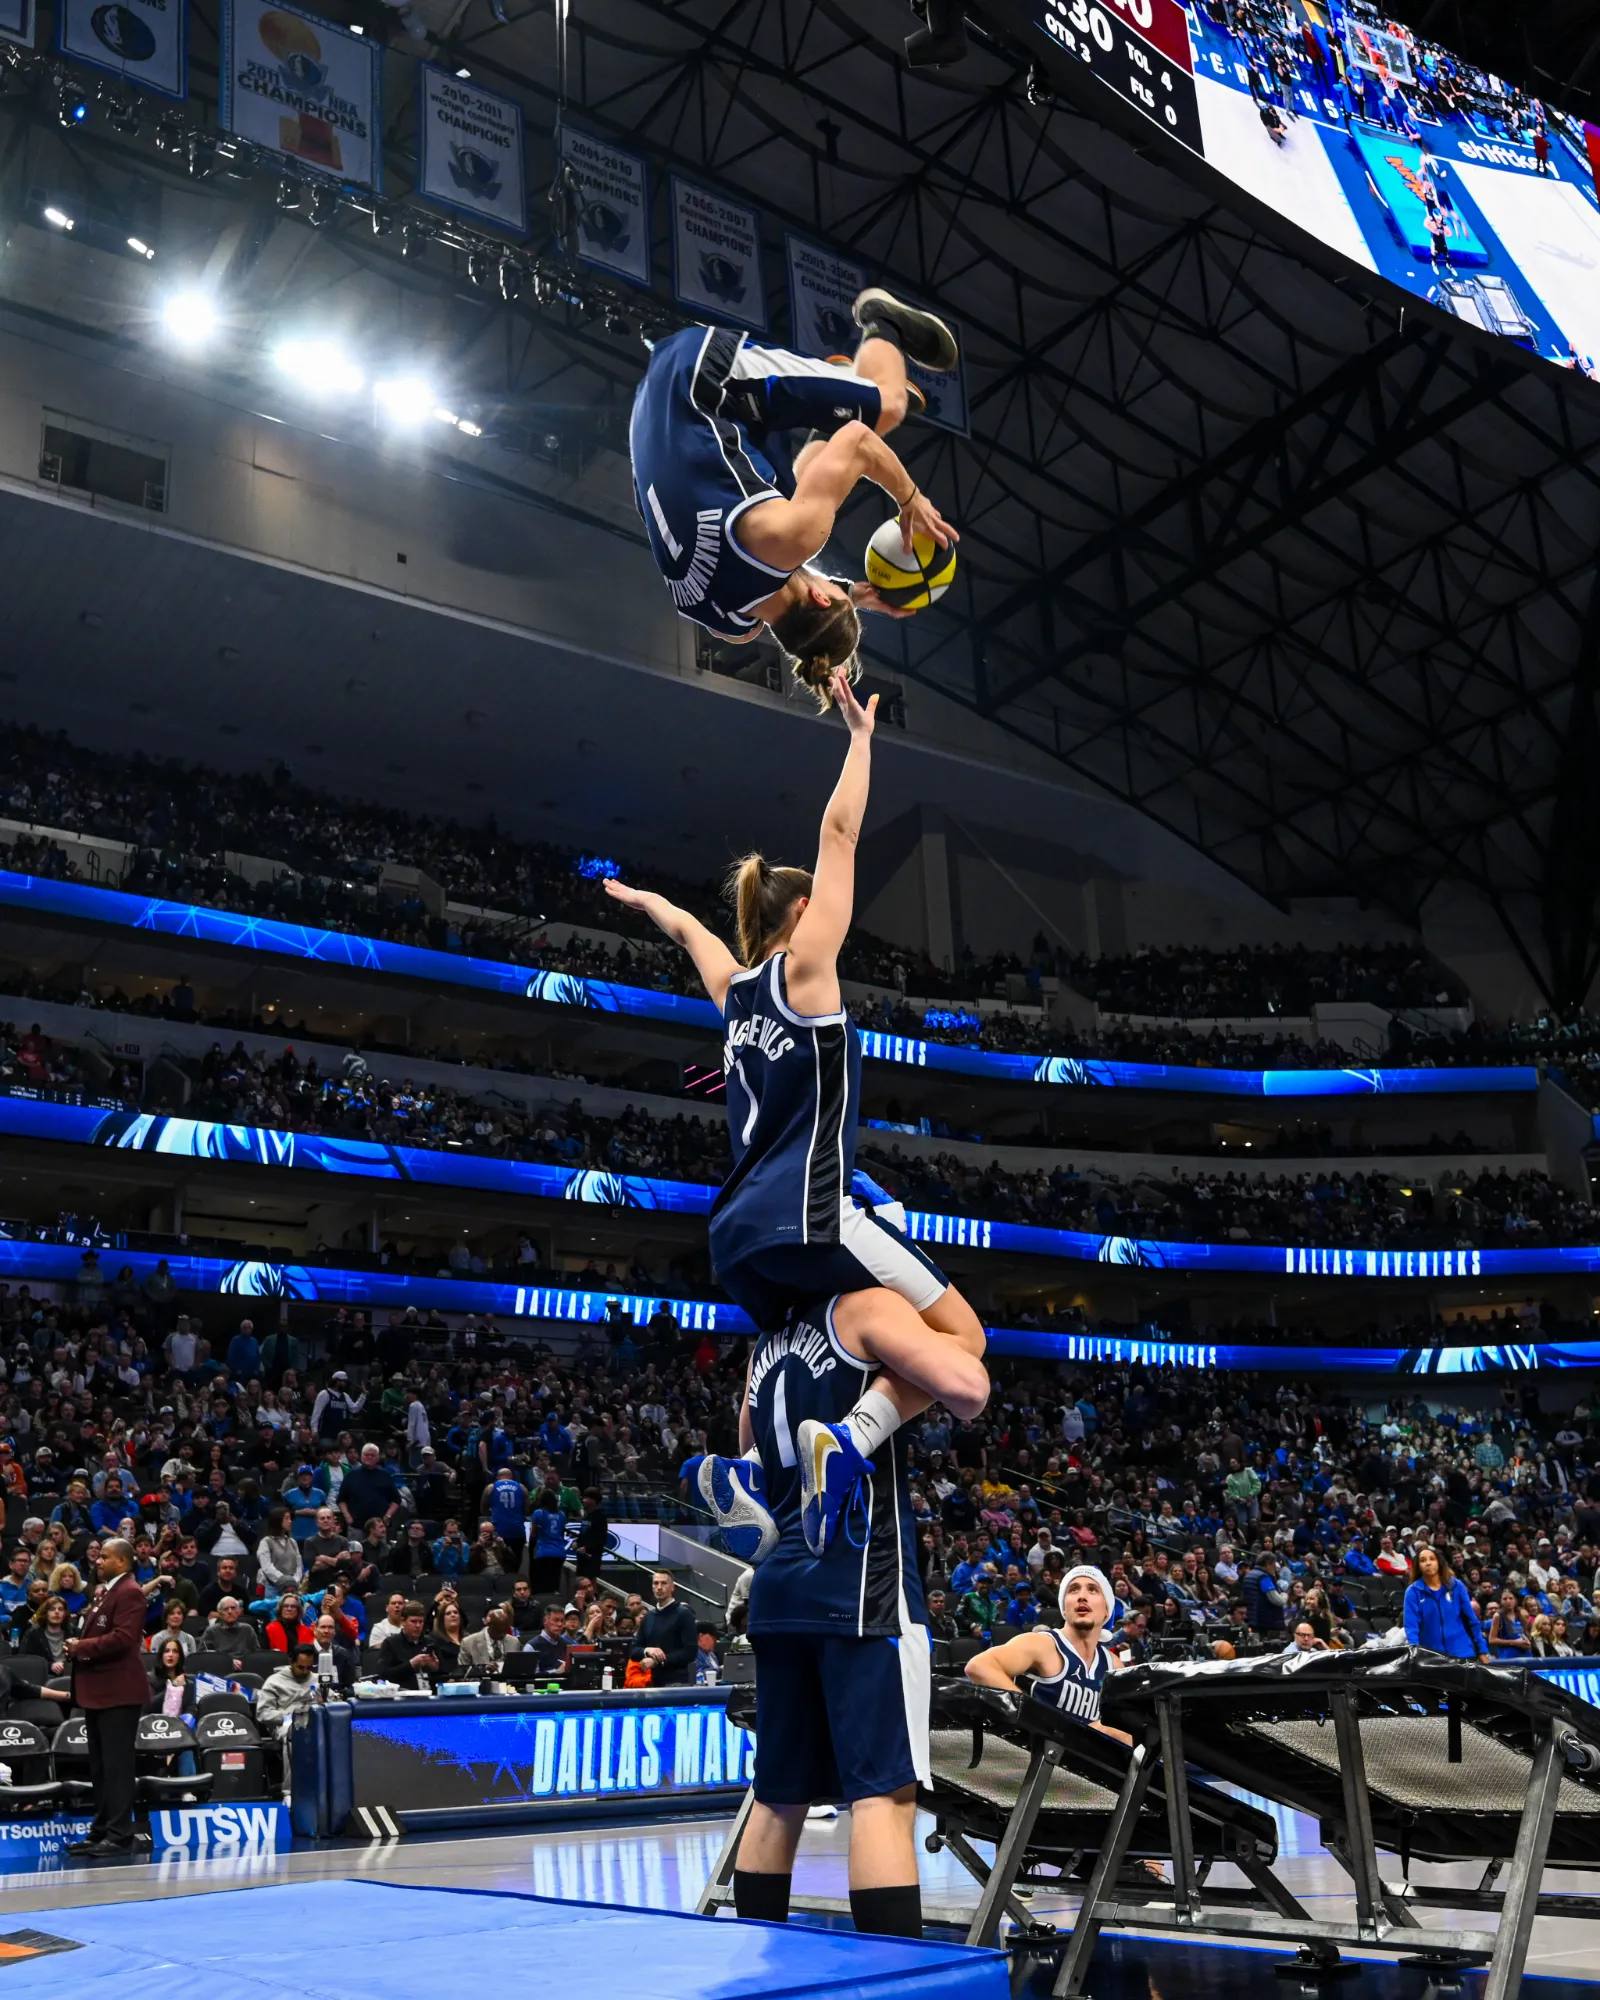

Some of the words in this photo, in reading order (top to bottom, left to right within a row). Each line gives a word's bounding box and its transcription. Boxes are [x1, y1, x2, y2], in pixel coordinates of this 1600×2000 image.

[1044, 12, 1077, 52] QTR
[1079, 42, 1092, 63] 3
[246, 59, 280, 85] 2011
[1125, 40, 1153, 76] TOL
[1160, 71, 1173, 92] 4
[237, 72, 367, 138] CHAMPIONS
[441, 84, 503, 120] 2010-2011
[1129, 75, 1156, 108] FLS
[1164, 104, 1177, 126] 0
[437, 108, 511, 149] CHAMPIONS
[685, 219, 753, 258] CHAMPIONS
[646, 483, 684, 562] 1
[1285, 1247, 1354, 1275] DALLAS
[1366, 1249, 1481, 1277] MAVERICKS
[514, 1287, 592, 1320] DALLAS
[748, 1326, 790, 1409] DUNKING
[788, 1321, 837, 1380] DEVILS
[773, 1369, 799, 1470] 1
[499, 1491, 516, 1509] 41
[550, 1519, 558, 1534] 2
[141, 1731, 182, 1740] LEXUS
[206, 1728, 248, 1737] LEXUS
[532, 1712, 663, 1795] DALLAS
[159, 1806, 278, 1846] UTSW
